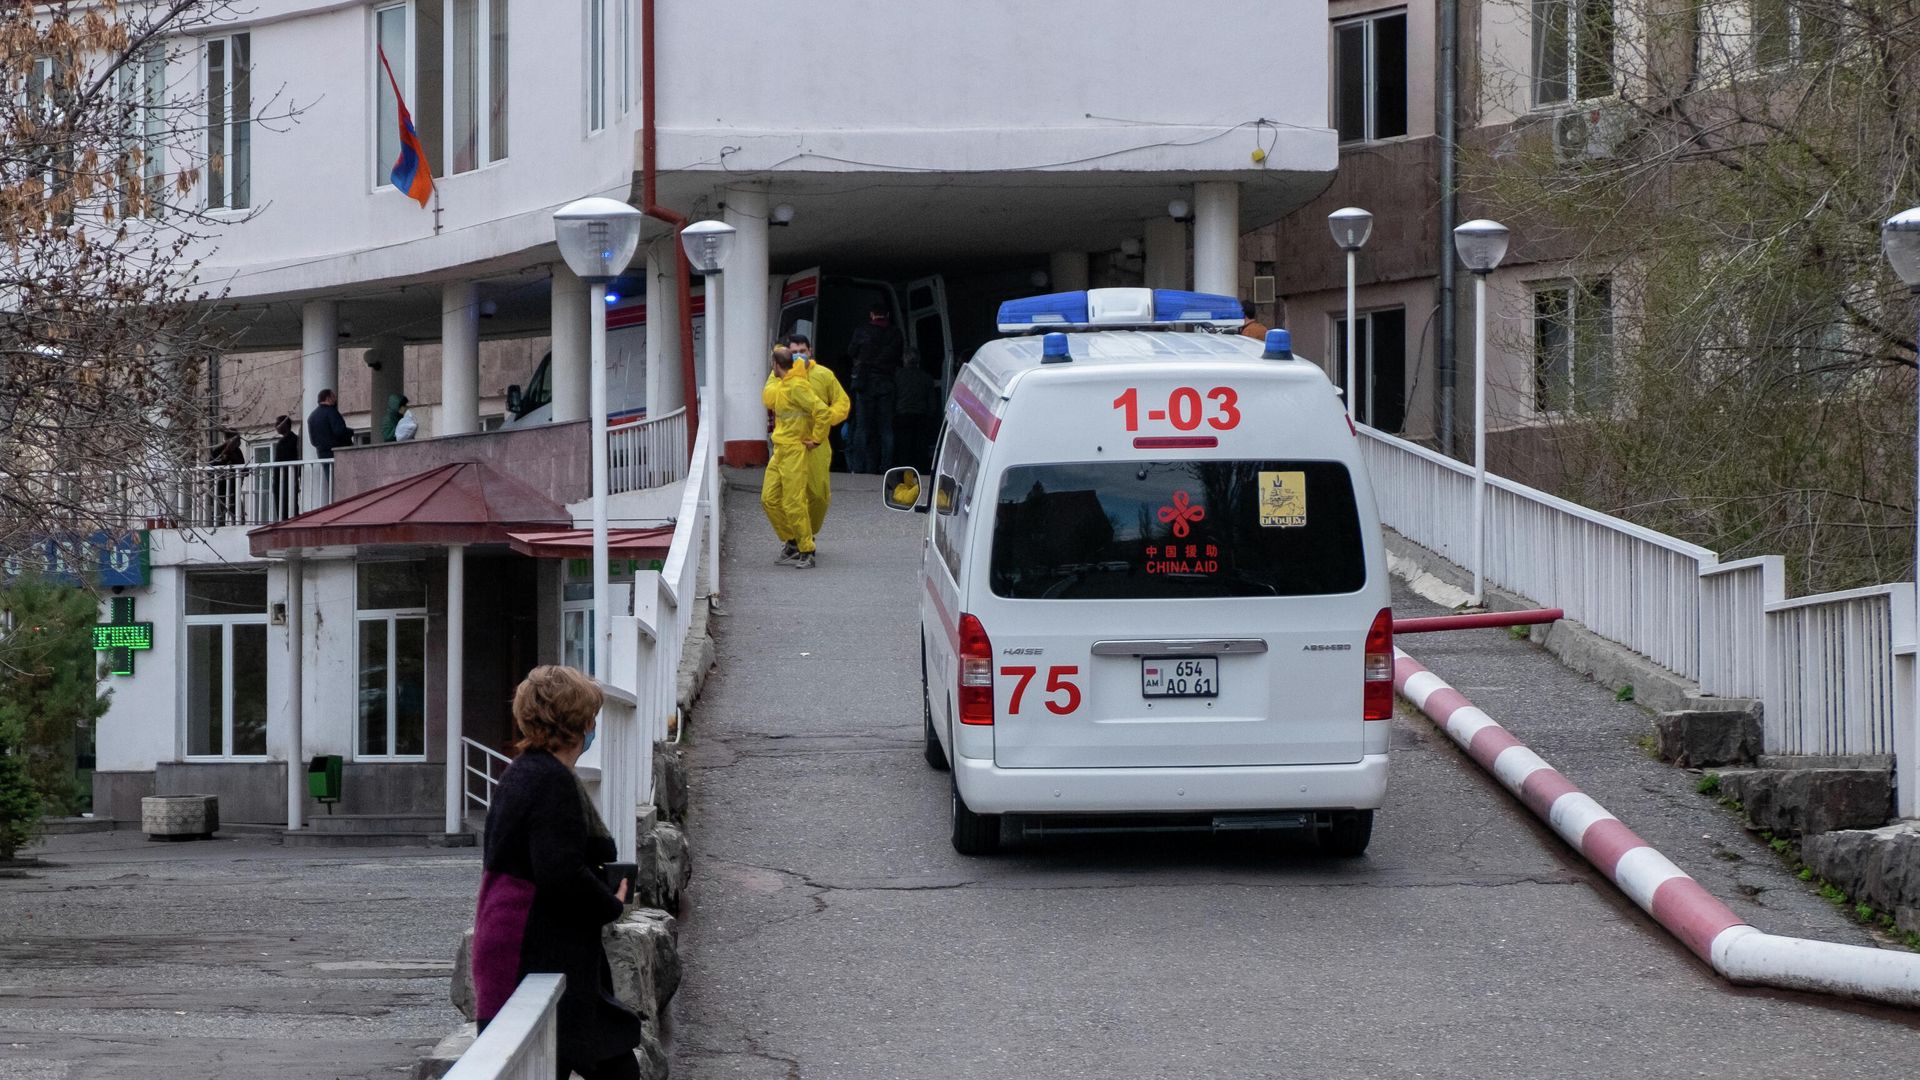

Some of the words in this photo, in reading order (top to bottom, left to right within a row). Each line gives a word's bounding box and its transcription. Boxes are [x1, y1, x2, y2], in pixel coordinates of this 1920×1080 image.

[1113, 387, 1241, 431] 1-03
[1145, 544, 1218, 558] 中国援助
[1146, 561, 1190, 574] CHINA
[1194, 560, 1218, 573] AID
[1176, 662, 1203, 677] 654
[1000, 666, 1081, 715] 75
[1194, 679, 1211, 694] 61
